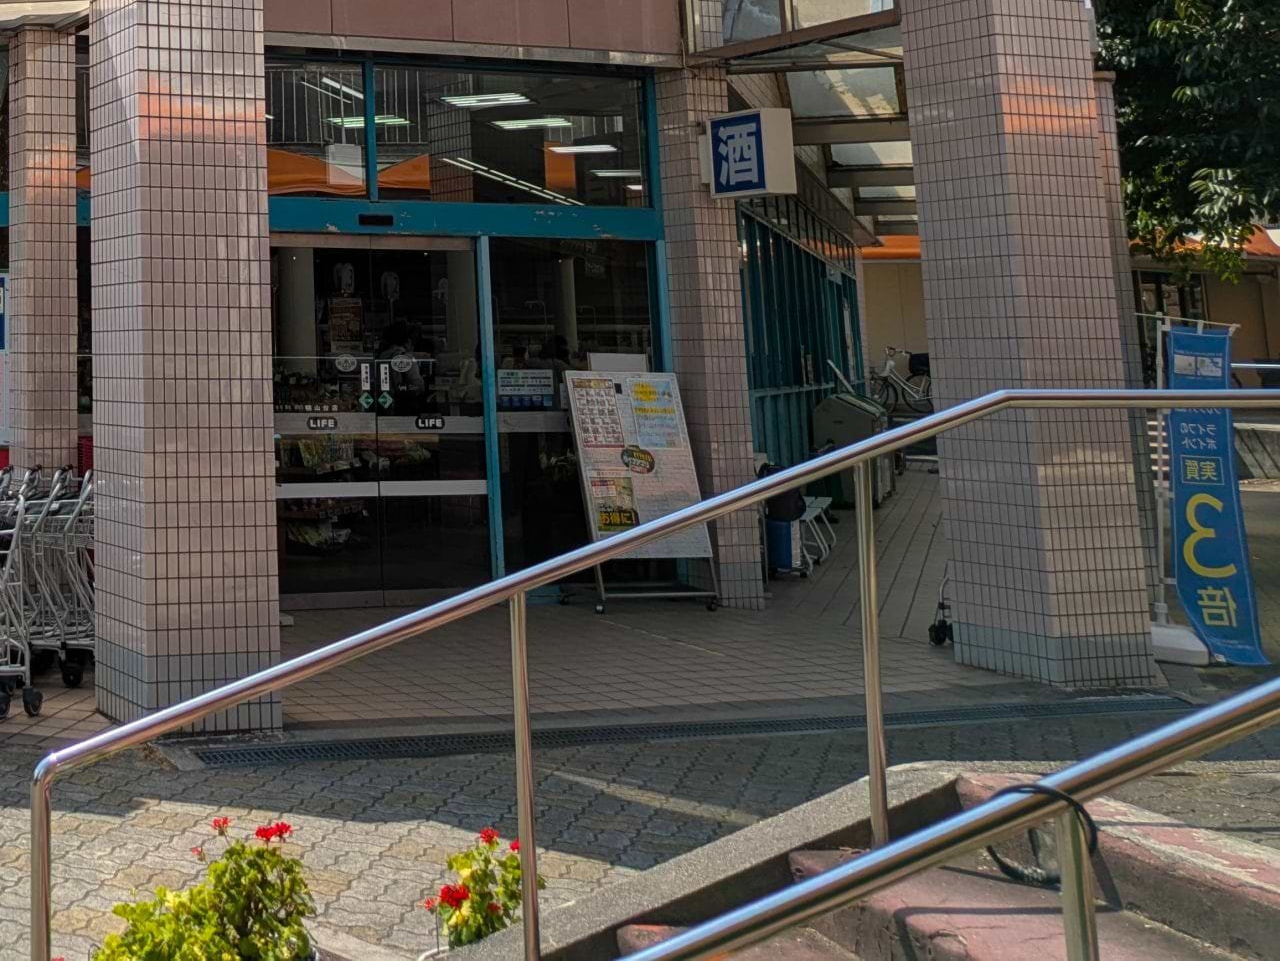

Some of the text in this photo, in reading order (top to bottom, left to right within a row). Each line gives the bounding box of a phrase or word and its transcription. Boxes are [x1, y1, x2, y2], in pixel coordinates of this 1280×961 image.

[718, 122, 759, 186] 酒
[310, 419, 335, 428] LIFE
[418, 419, 443, 428] LIFE
